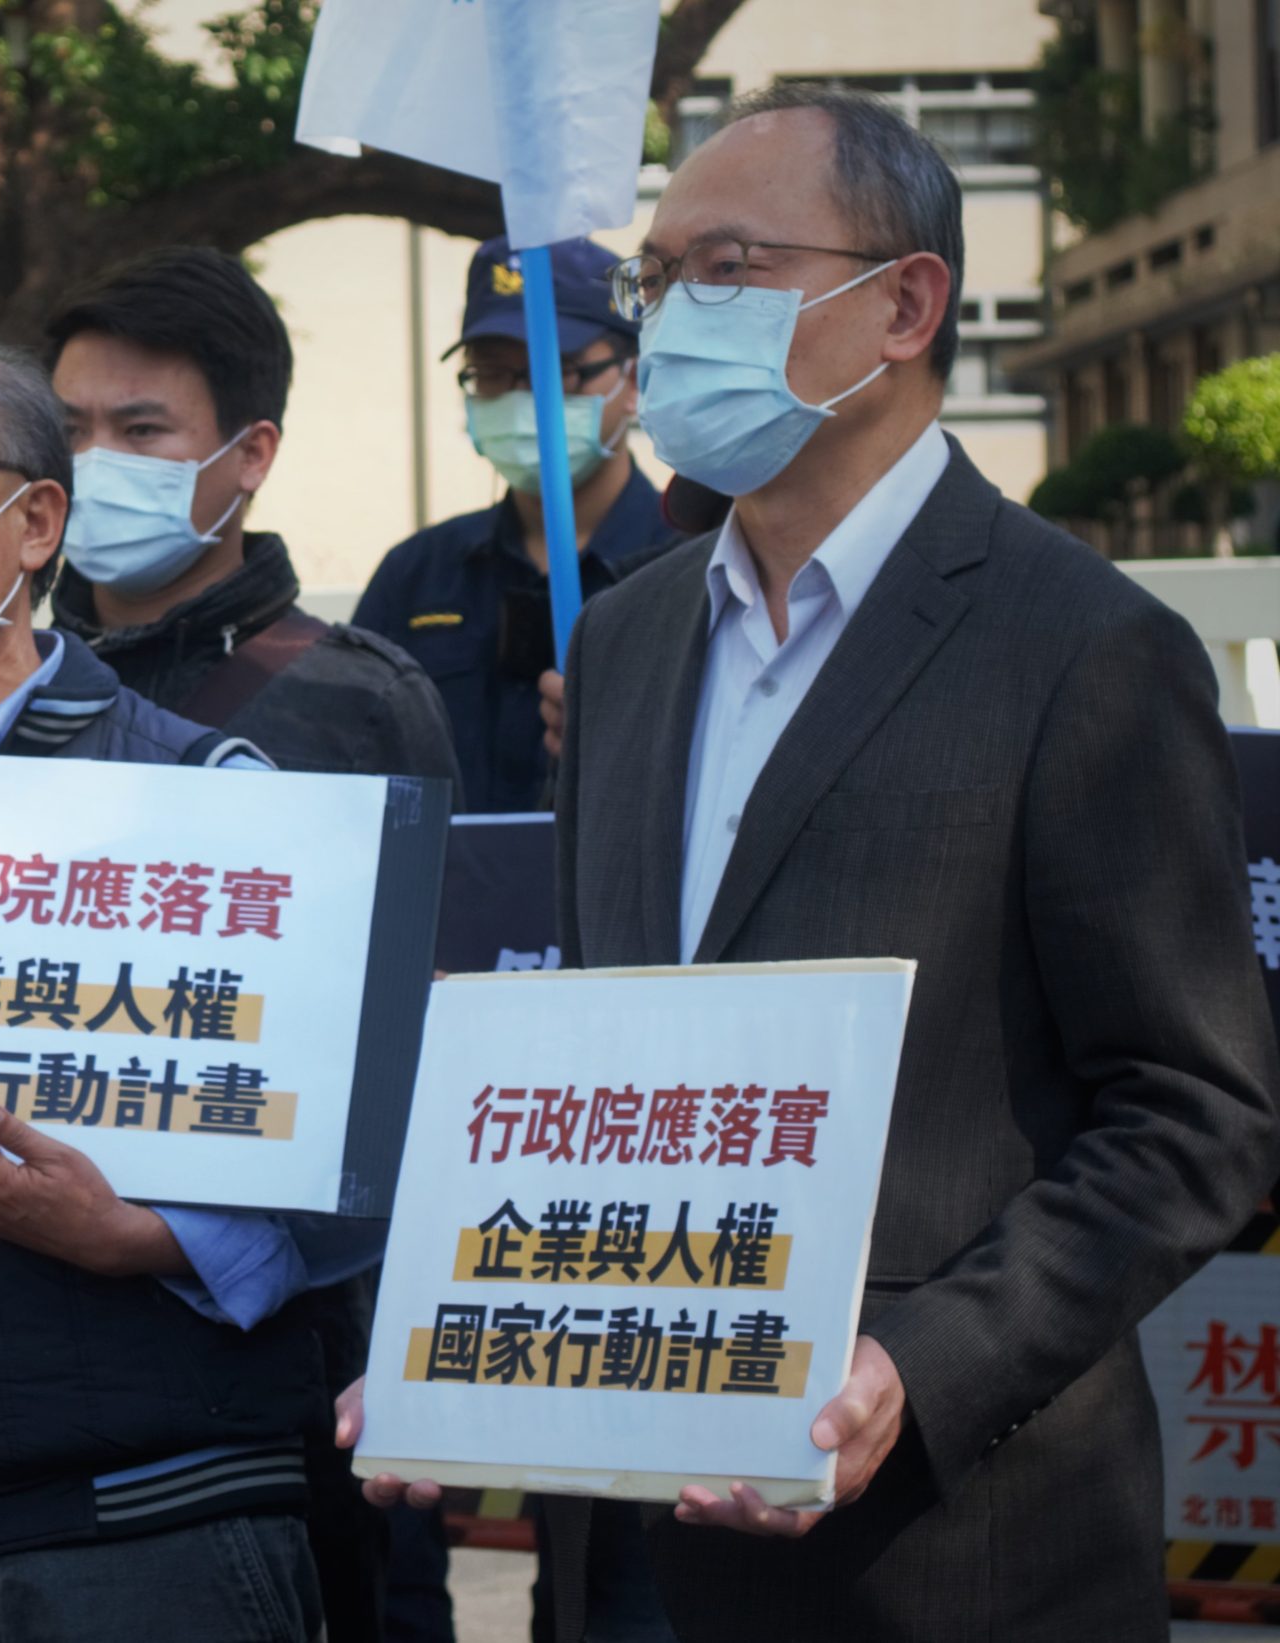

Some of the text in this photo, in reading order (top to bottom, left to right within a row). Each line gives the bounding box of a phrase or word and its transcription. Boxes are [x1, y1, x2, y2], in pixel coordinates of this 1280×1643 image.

[466, 1083, 830, 1167] 行政院應落實
[472, 1198, 779, 1287] 企業與人權
[425, 1302, 790, 1395] 國家行動計畫
